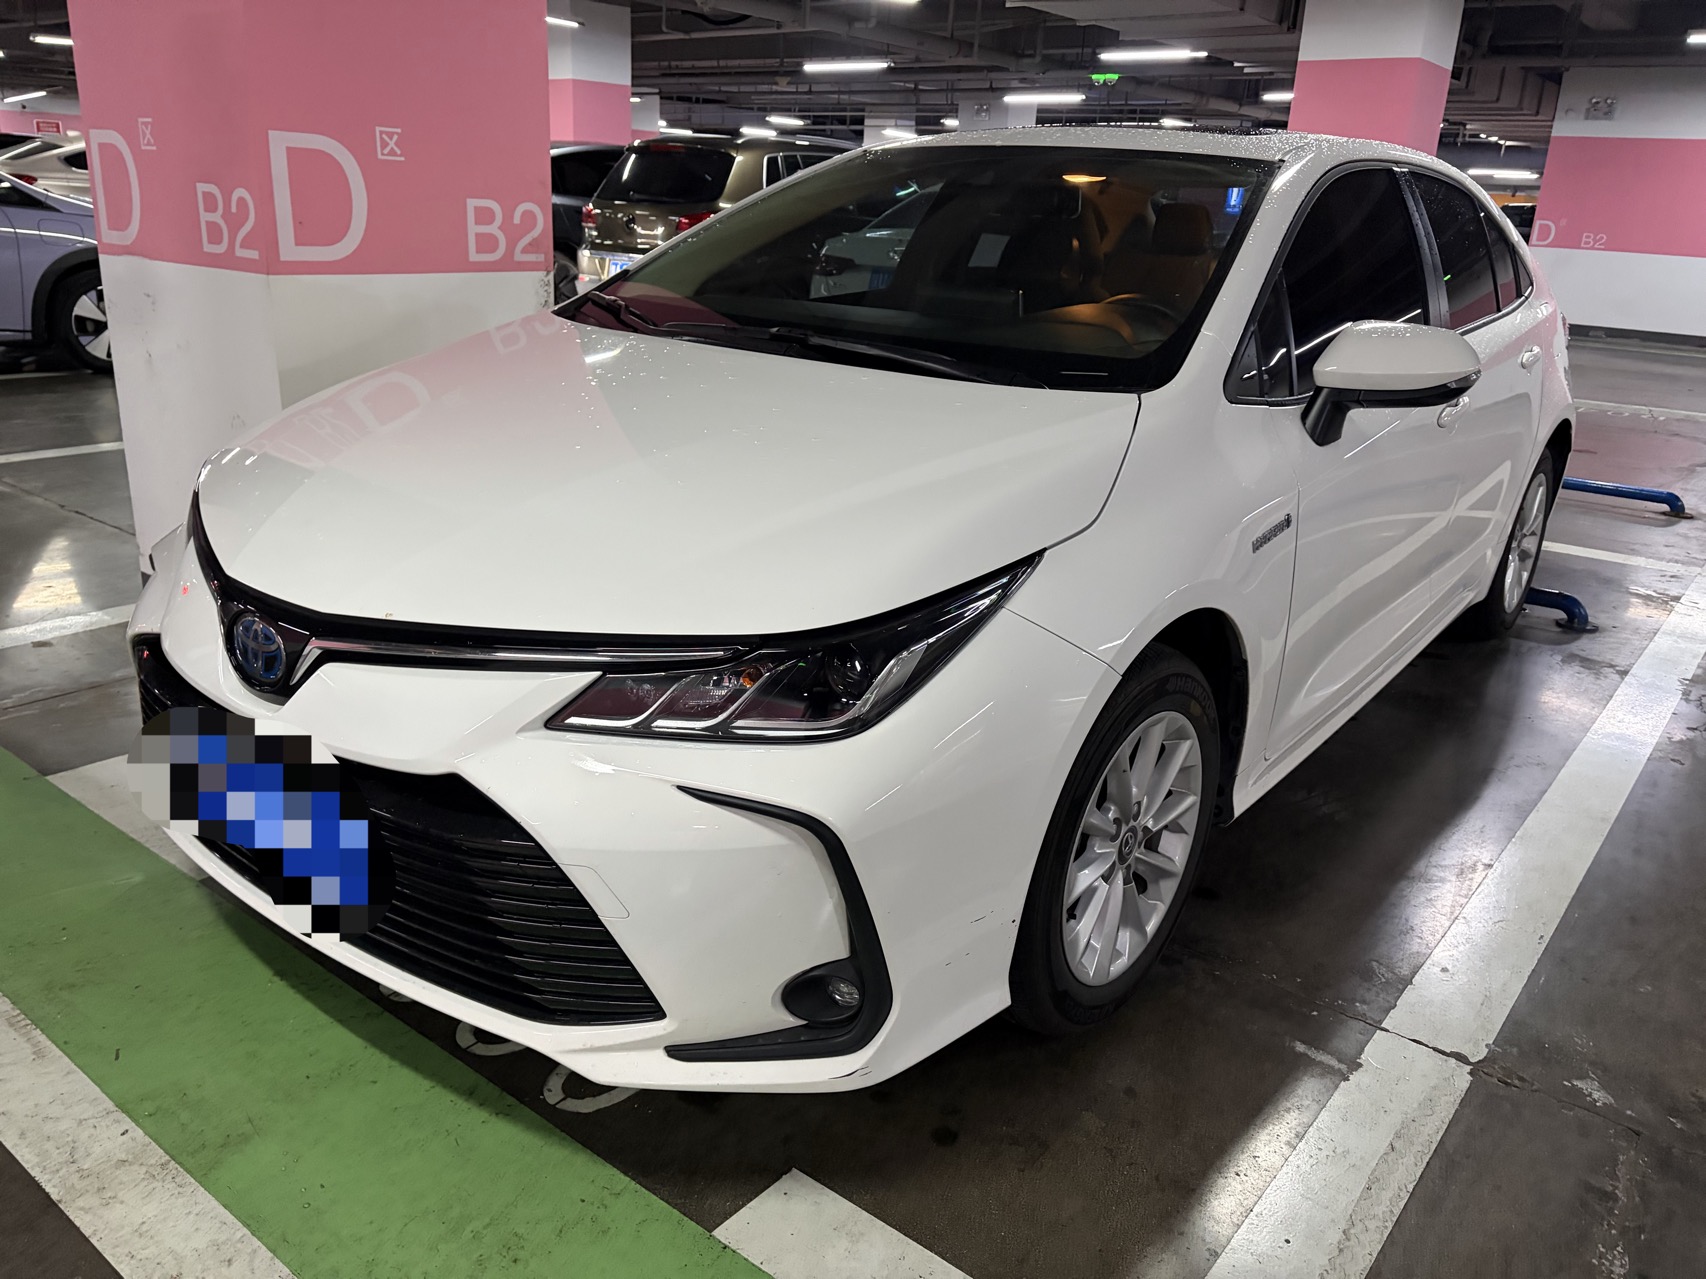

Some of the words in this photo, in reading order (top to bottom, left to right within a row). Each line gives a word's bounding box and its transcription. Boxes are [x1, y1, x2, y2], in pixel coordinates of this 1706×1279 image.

[138, 118, 156, 150] 区
[375, 126, 405, 161] 区
[88, 129, 140, 245] D
[268, 130, 368, 262] D
[196, 182, 259, 260] B2
[466, 197, 545, 262] B2
[1531, 219, 1556, 246] D
[1581, 232, 1608, 249] B2
